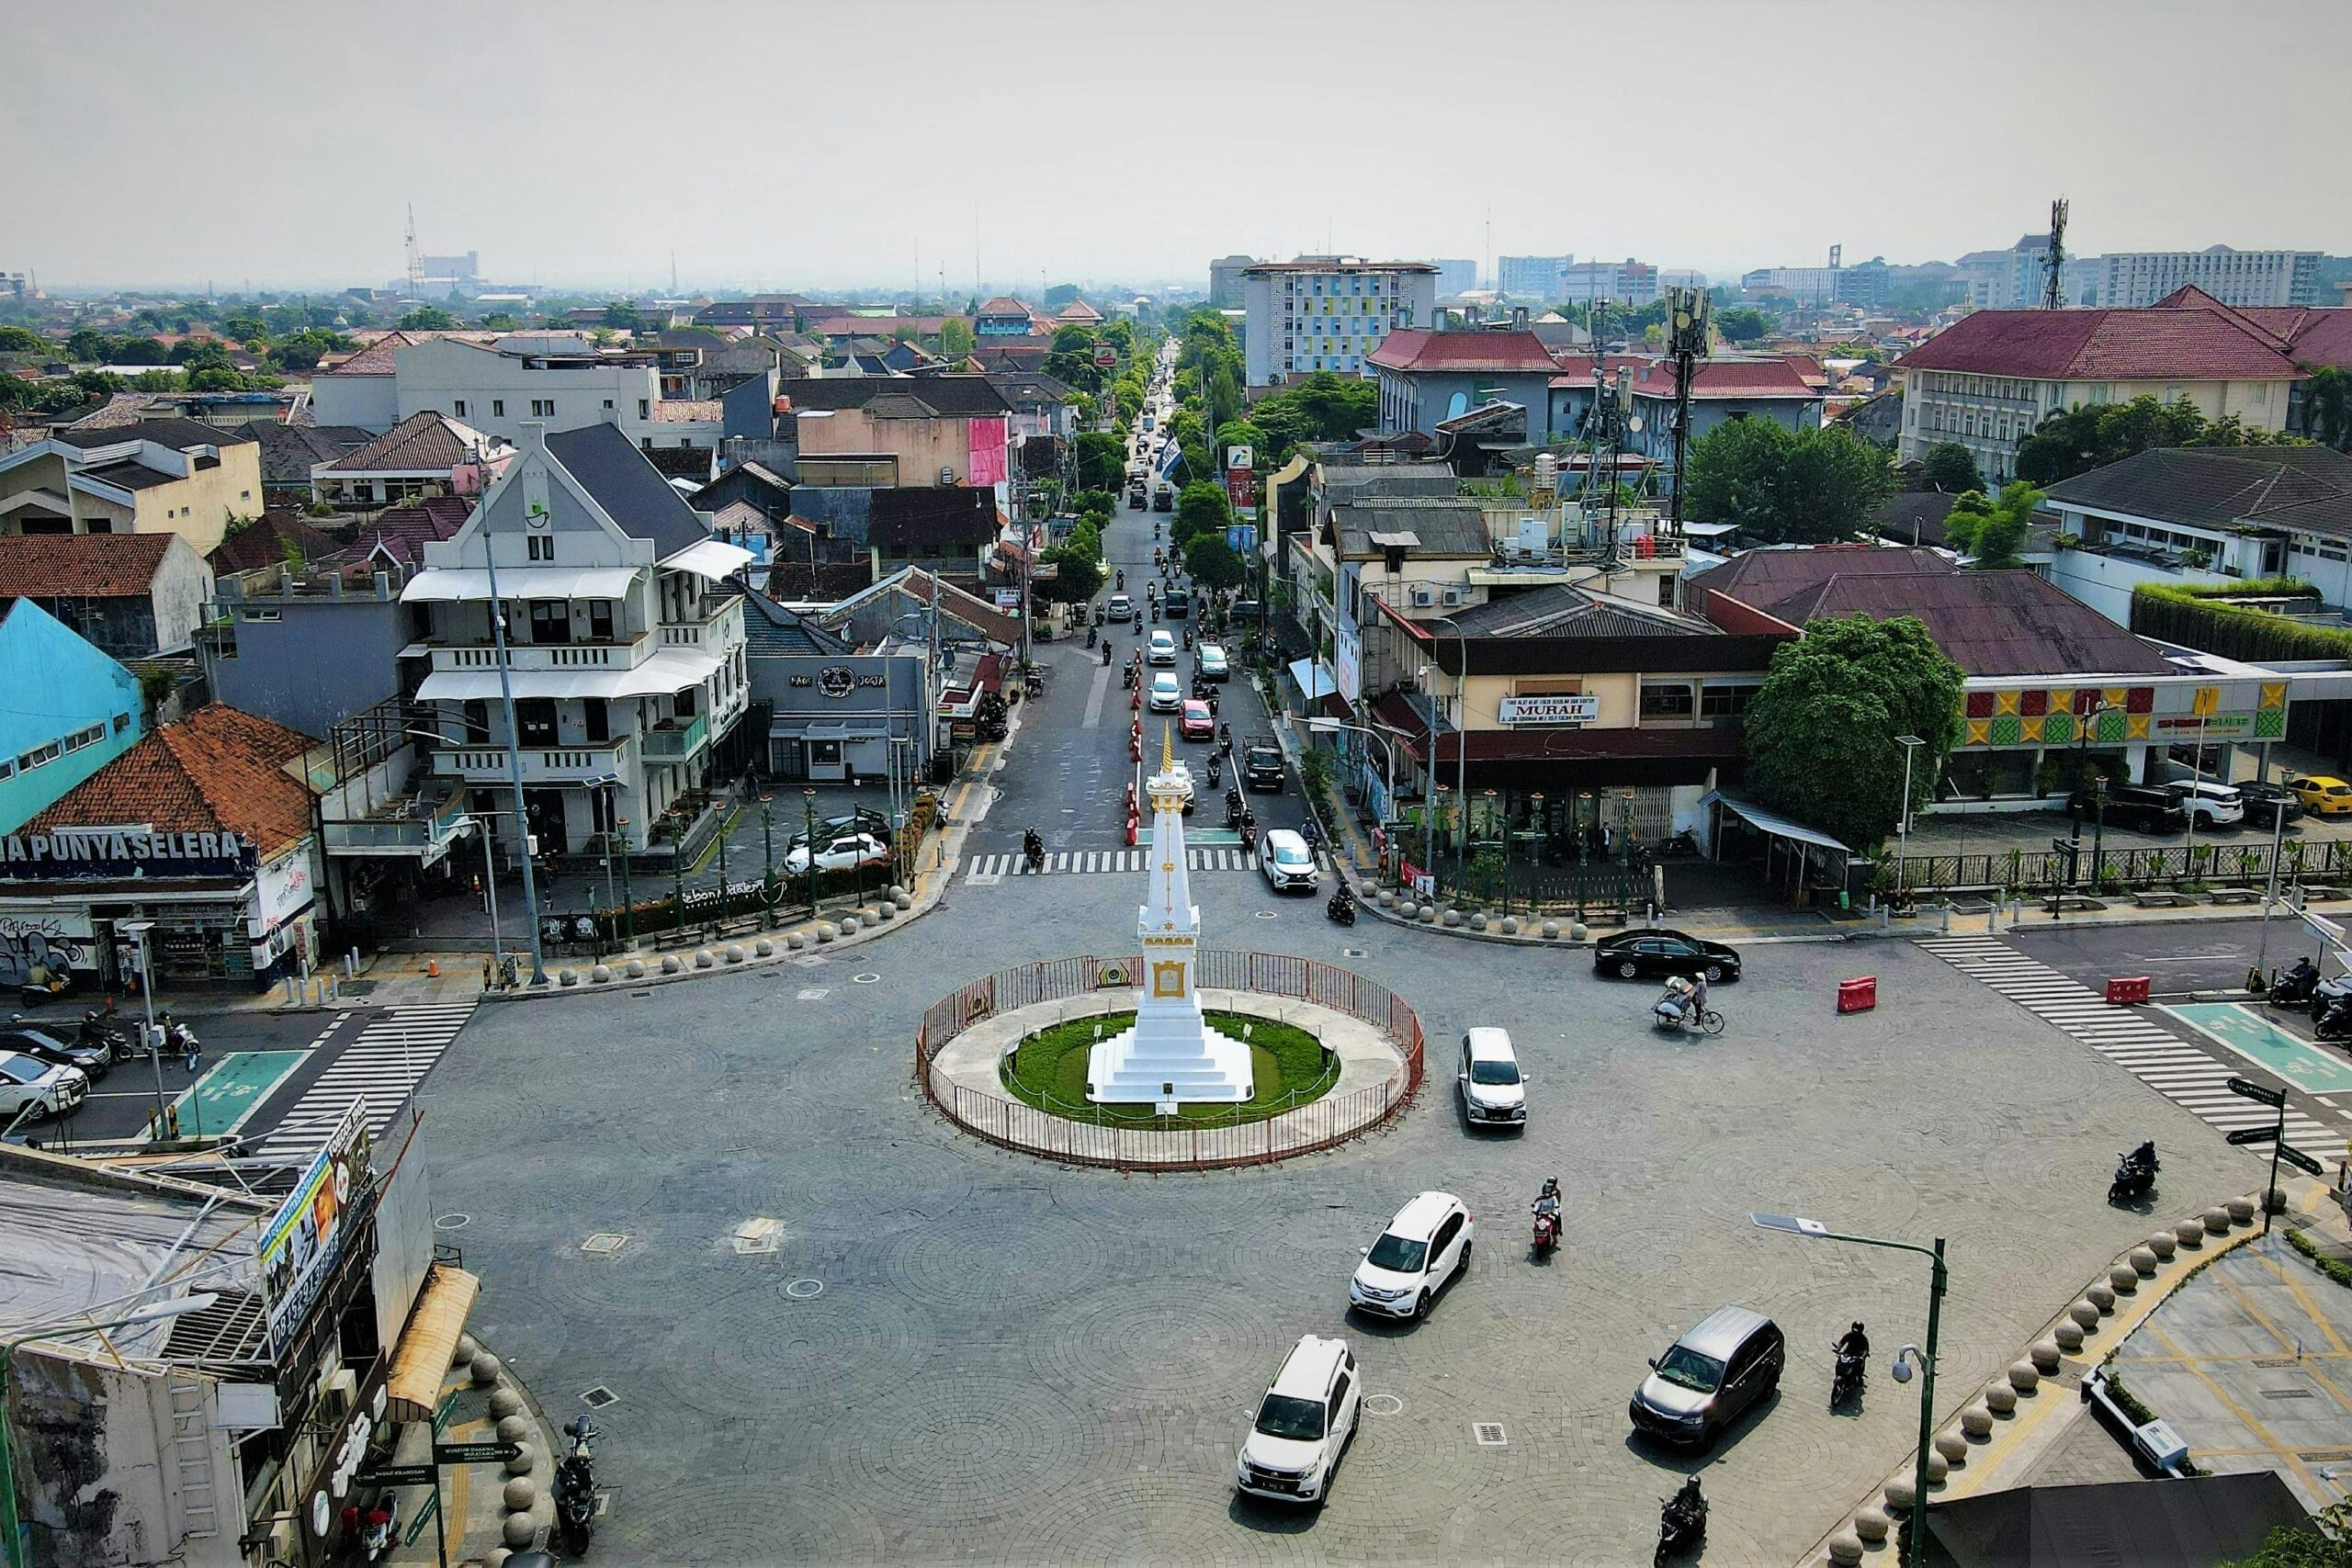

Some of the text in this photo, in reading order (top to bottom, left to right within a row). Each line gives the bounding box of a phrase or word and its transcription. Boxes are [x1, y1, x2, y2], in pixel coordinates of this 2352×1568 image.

[859, 676, 886, 685] JOGJA
[1516, 705, 1583, 716] MURAH
[30, 833, 131, 862] PUNYA
[130, 831, 242, 859] SELERA
